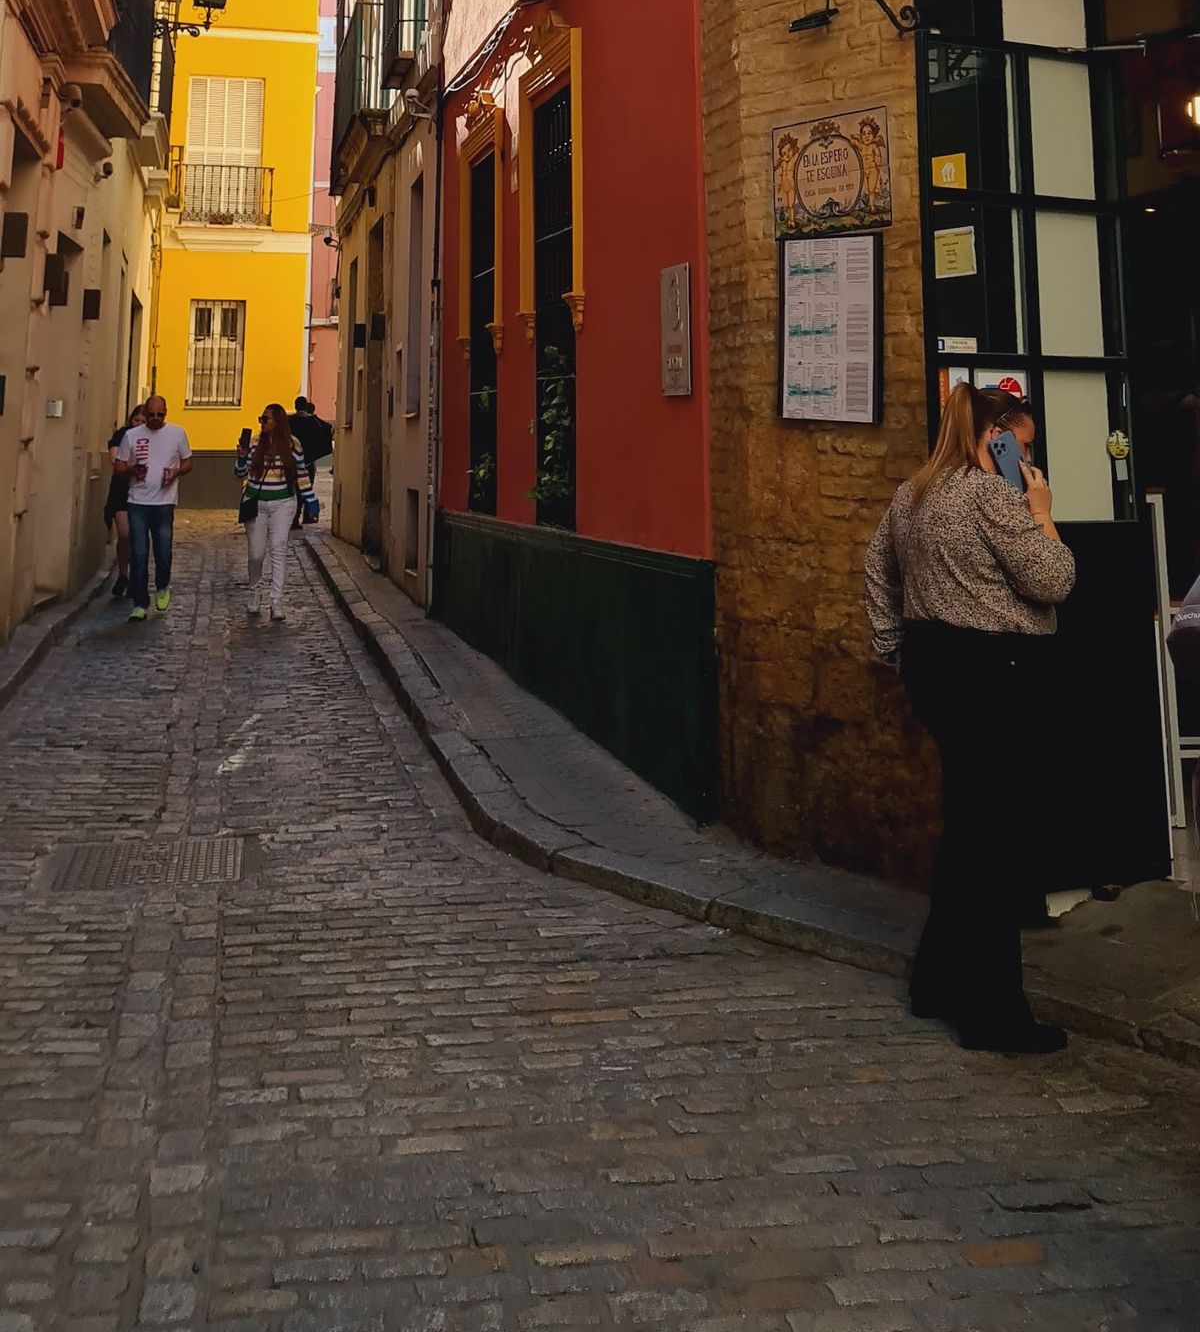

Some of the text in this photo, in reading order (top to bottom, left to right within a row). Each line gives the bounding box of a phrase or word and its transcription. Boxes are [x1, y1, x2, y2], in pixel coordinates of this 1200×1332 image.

[820, 148, 848, 165] ESPERO
[806, 164, 847, 183] TE ESQUINA
